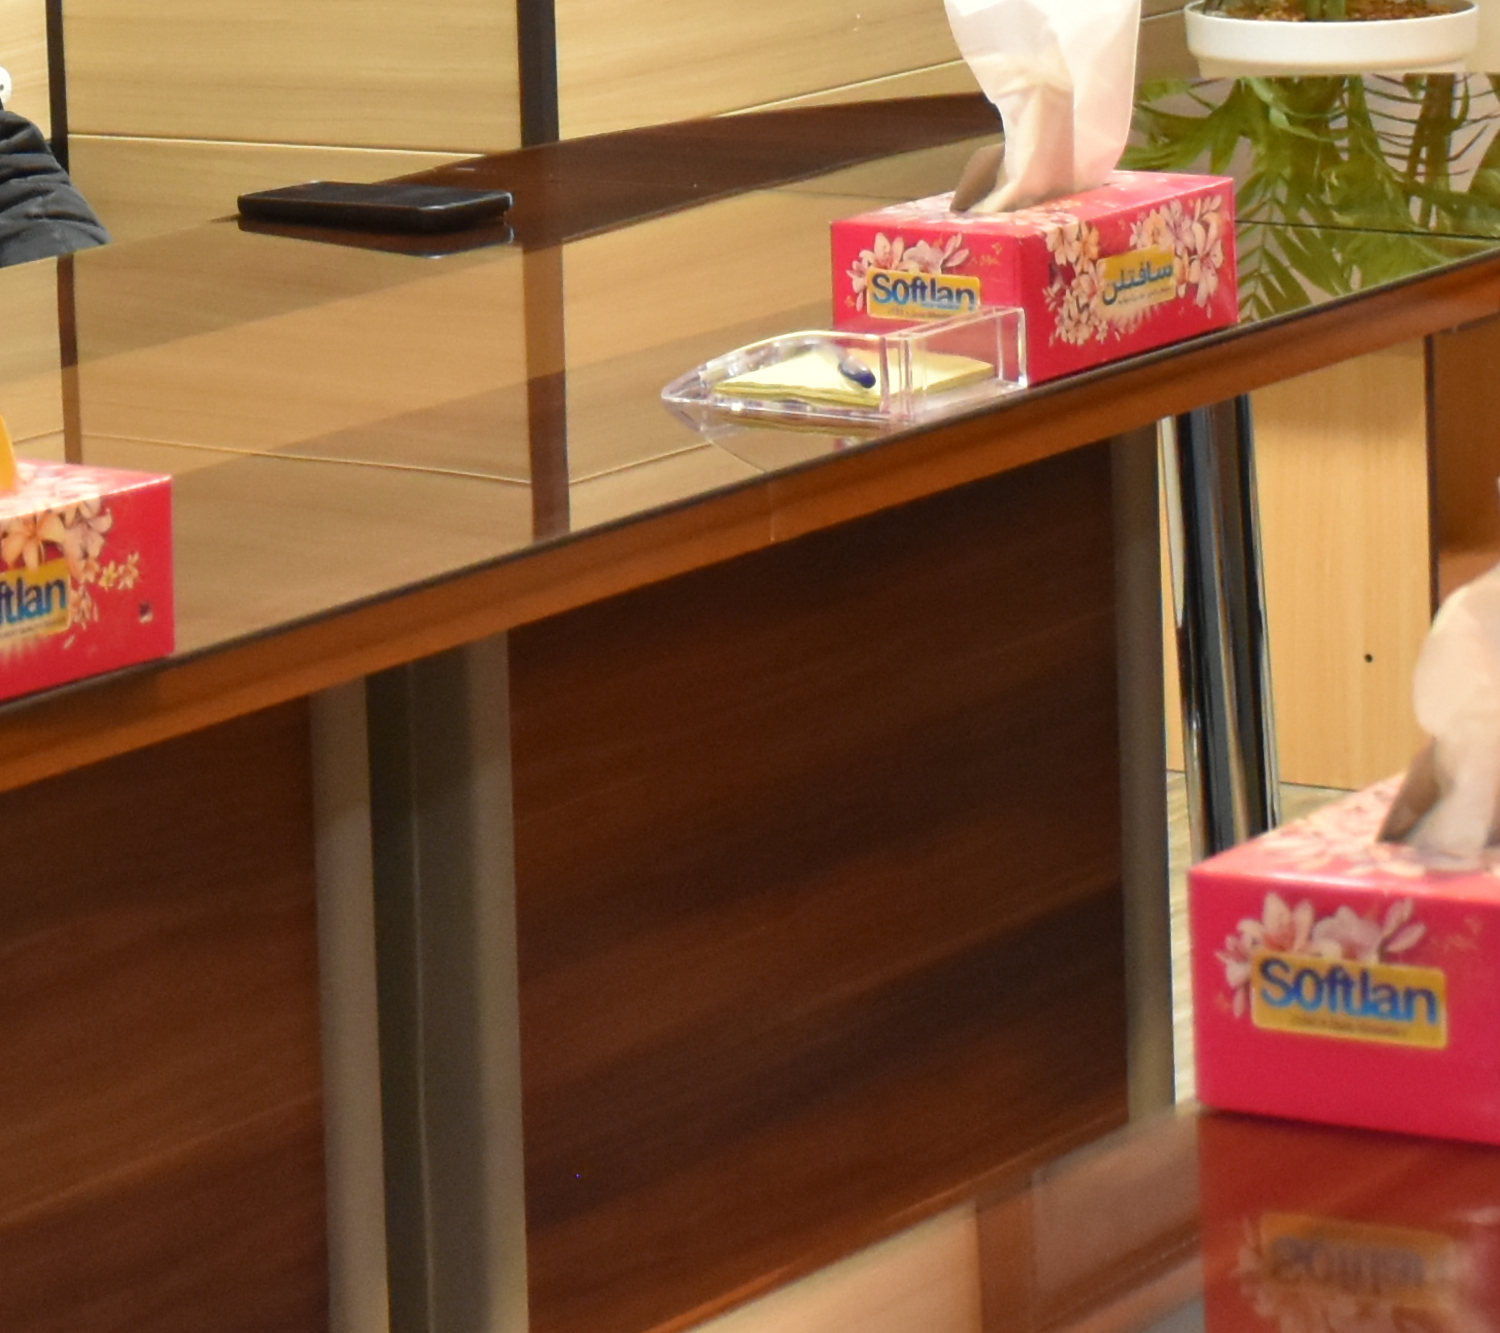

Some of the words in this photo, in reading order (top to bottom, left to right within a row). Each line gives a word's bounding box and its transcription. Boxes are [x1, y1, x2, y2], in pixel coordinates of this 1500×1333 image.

[871, 273, 976, 312] Softlan
[1102, 260, 1173, 306] سافتلن
[1260, 957, 1439, 1027] Softlan
